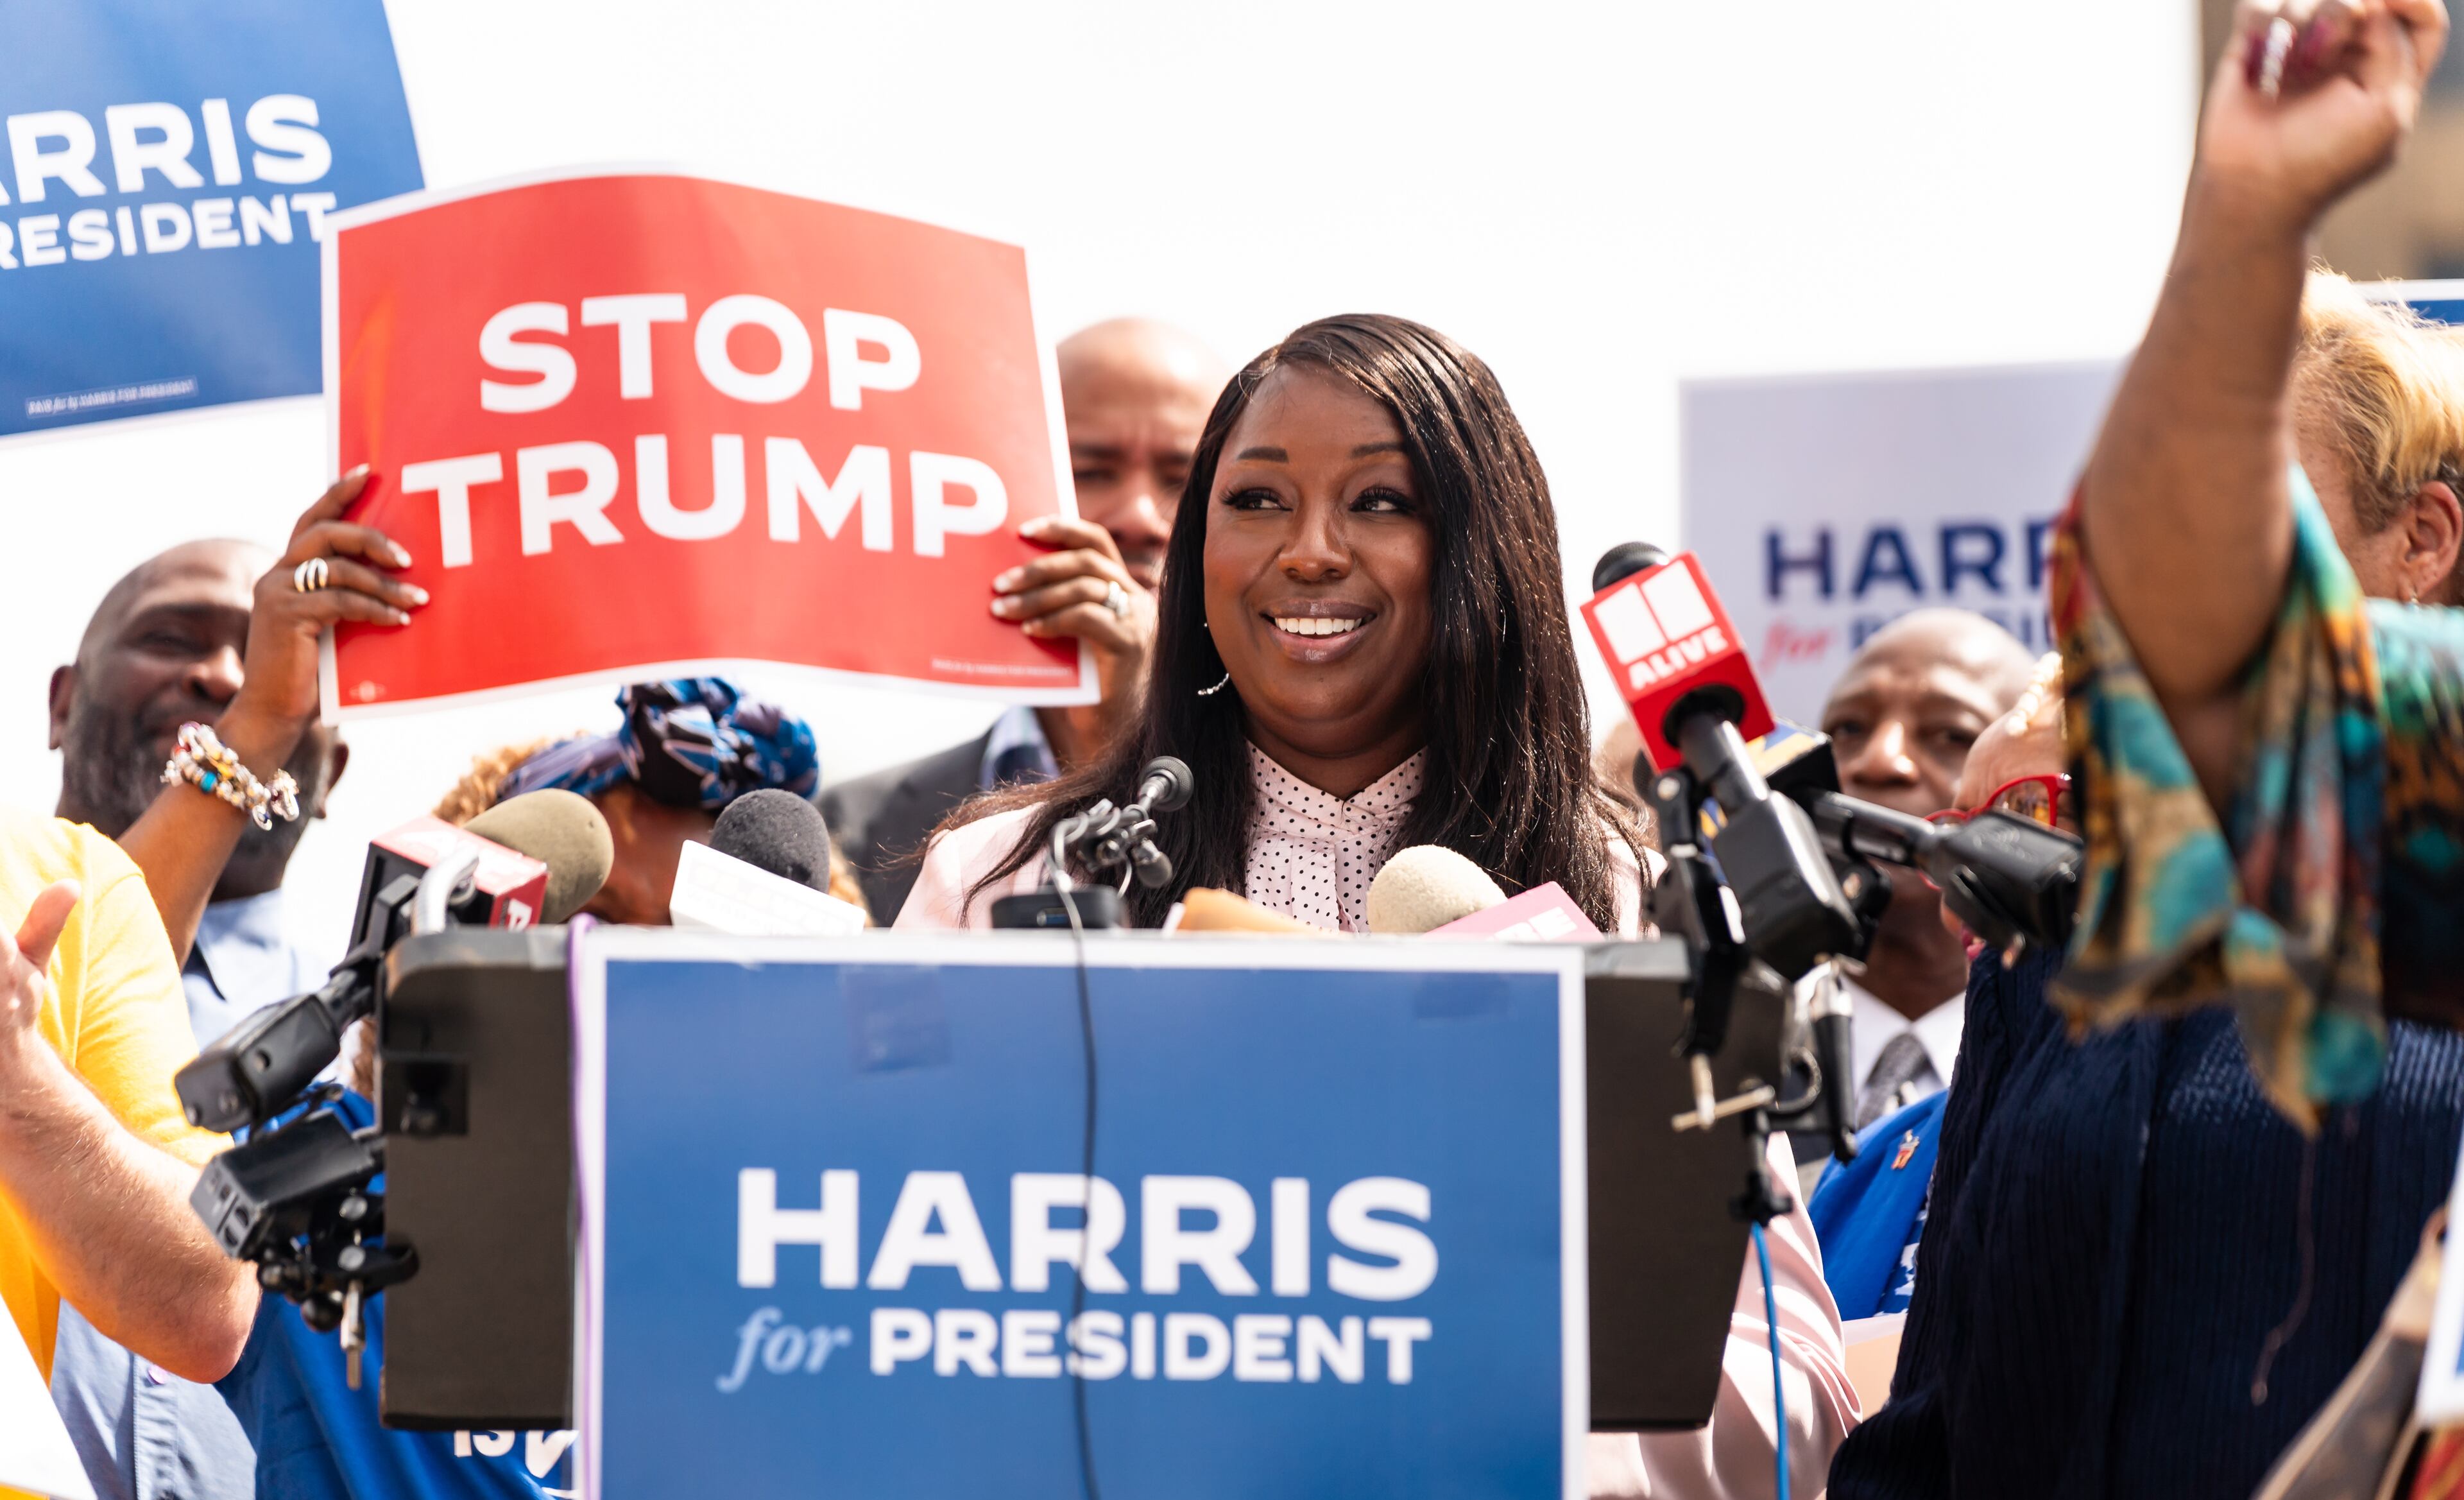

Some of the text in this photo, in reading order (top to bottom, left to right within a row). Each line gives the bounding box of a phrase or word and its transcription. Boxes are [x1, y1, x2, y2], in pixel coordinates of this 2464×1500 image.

[0, 94, 332, 206] RRIS
[478, 293, 923, 415] STOP
[401, 434, 1009, 569] TRUMP
[1628, 625, 1729, 691] ALIVE
[737, 1168, 1438, 1300] HARRIS
[716, 1307, 1432, 1392] for PRESIDENT
